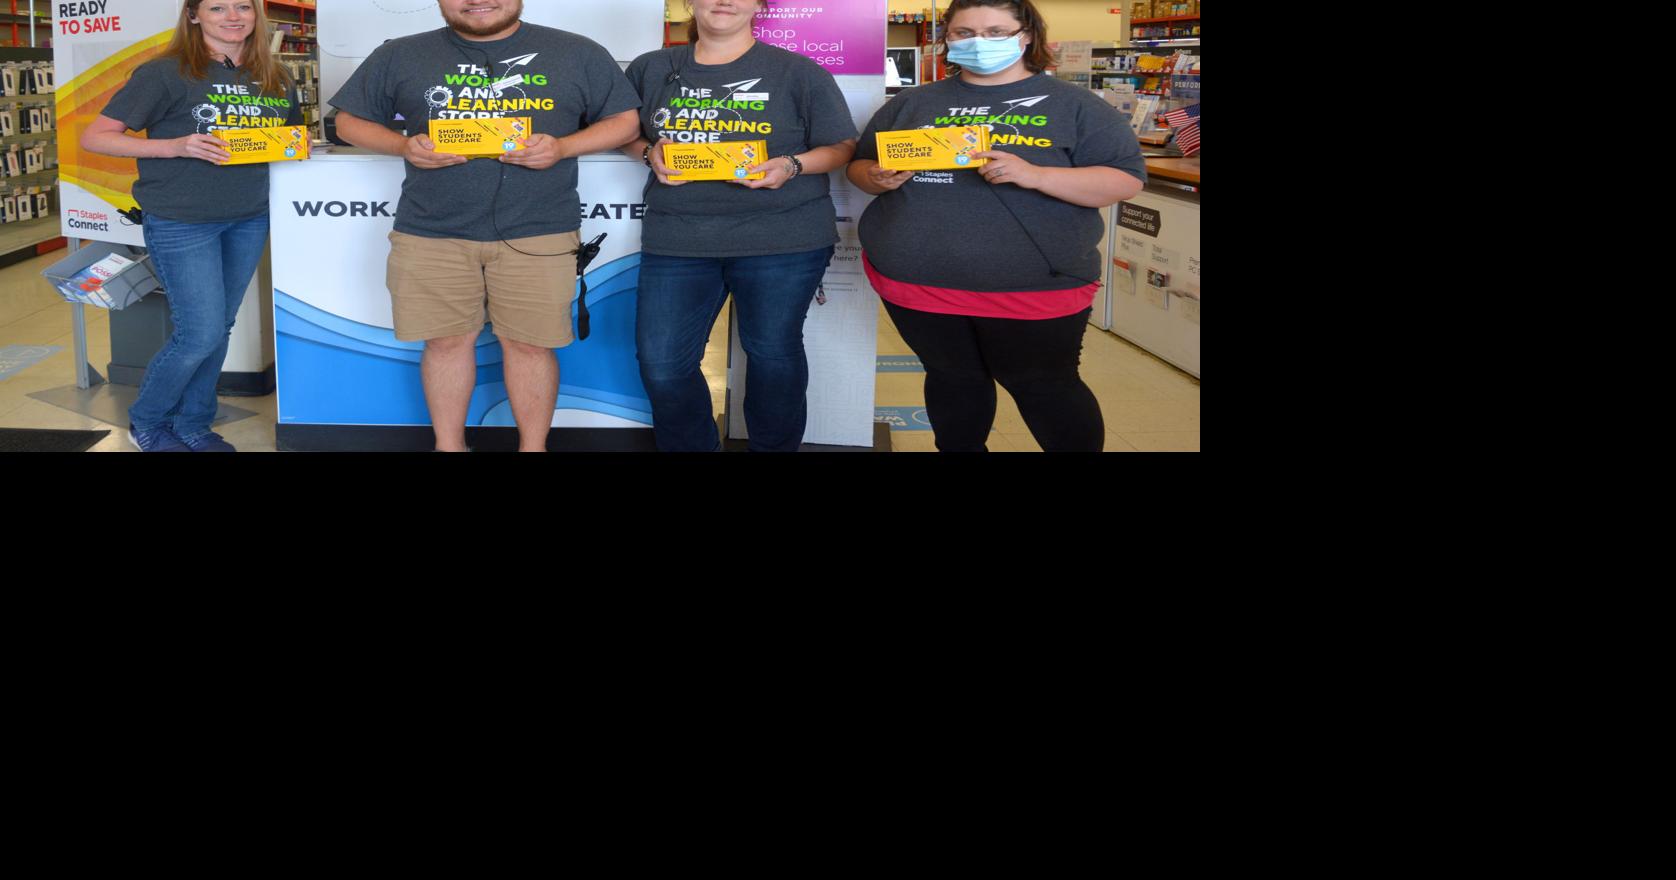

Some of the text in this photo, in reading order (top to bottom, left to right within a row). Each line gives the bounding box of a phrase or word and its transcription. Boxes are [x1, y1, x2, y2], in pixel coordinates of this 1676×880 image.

[59, 0, 107, 17] READY
[59, 16, 121, 35] TO SAVE
[753, 26, 796, 39] Shop
[803, 39, 843, 52] local
[457, 64, 488, 77] TH
[212, 84, 250, 95] THE
[681, 86, 713, 98] THE
[206, 94, 290, 108] WORKING
[446, 97, 555, 111] LEARNING
[670, 97, 765, 111] WORKING
[225, 104, 261, 116] AND
[675, 108, 718, 119] AND
[948, 106, 991, 116] THE
[664, 118, 773, 134] LEARNING
[935, 115, 1048, 126] WORKING
[658, 130, 721, 143] STORE
[886, 146, 933, 154] STUDENTS
[912, 175, 955, 183] Connect
[80, 210, 109, 221] Staples
[292, 201, 396, 217] WORK.
[68, 218, 109, 232] Connect
